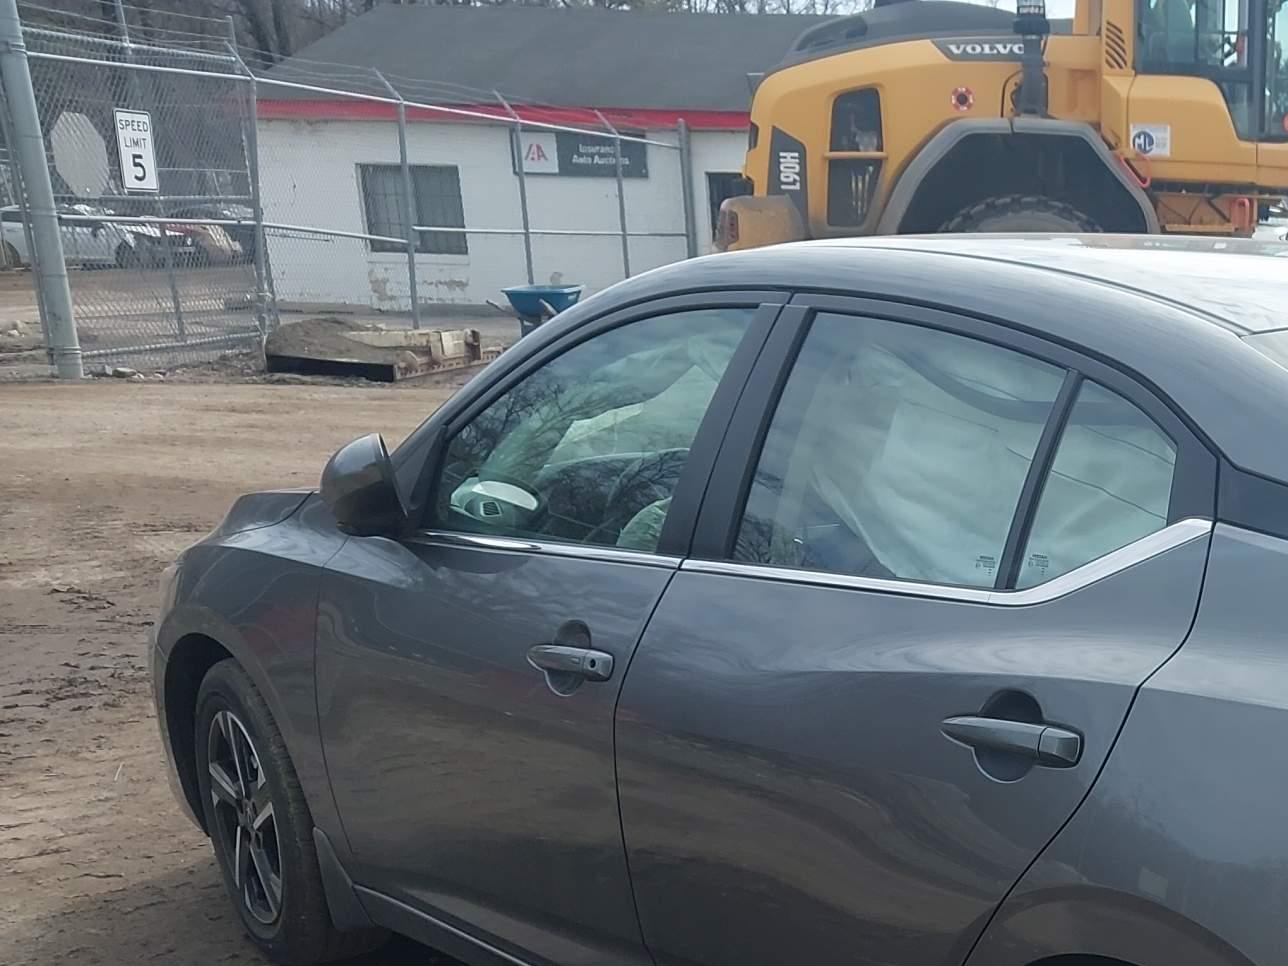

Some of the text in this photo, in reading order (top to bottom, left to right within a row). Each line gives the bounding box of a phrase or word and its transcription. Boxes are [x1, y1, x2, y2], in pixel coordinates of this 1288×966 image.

[118, 119, 149, 132] SPEED
[123, 136, 147, 149] LIMIT
[131, 153, 146, 182] 5
[779, 151, 800, 190] L90H
